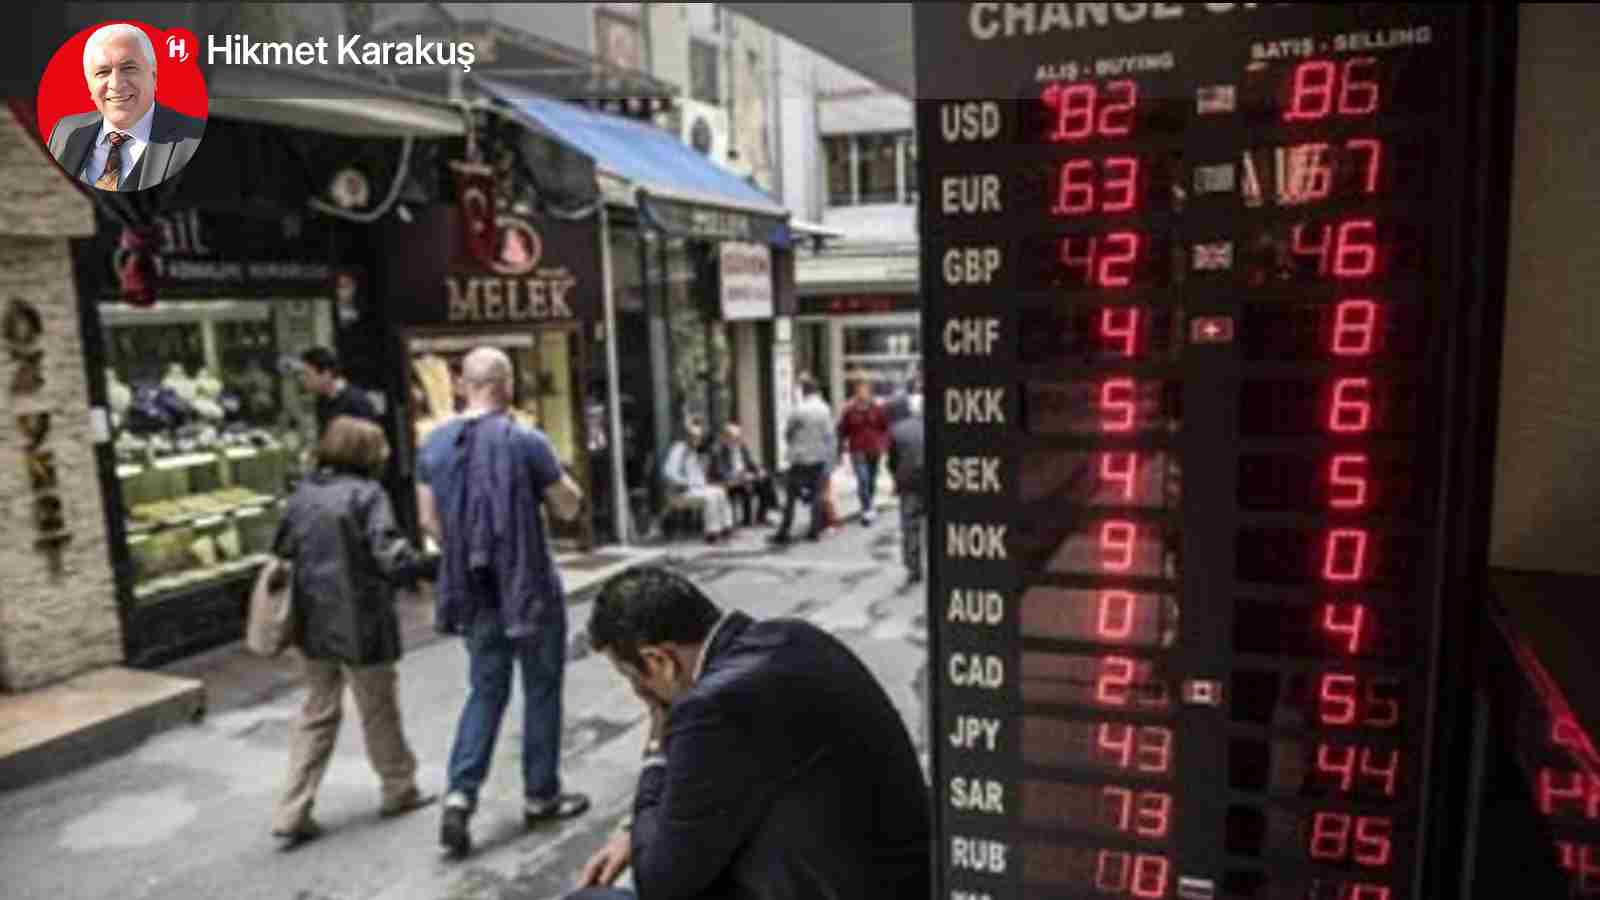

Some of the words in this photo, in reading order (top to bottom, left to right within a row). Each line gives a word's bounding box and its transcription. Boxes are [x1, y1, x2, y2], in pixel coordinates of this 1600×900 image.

[1096, 52, 1174, 76] BUYING
[942, 101, 1001, 141] USD
[942, 174, 1002, 214] EUR
[943, 248, 1000, 285] GBP
[445, 277, 577, 320] MELEK
[943, 318, 1000, 356] CHF
[1101, 306, 1138, 356] 4
[1331, 300, 1376, 356] 8
[946, 387, 1005, 424] DKK
[1100, 378, 1136, 432] 5
[1329, 378, 1371, 433] 6
[946, 456, 1001, 493] SEK
[1100, 451, 1137, 501] 4
[1329, 455, 1368, 508] 5
[947, 522, 1007, 559] NOK
[1100, 520, 1136, 572] 9
[1322, 529, 1367, 582] 0
[947, 588, 1004, 624] AUD
[1098, 589, 1136, 639] 0
[1323, 603, 1364, 653] 4
[950, 652, 1004, 689] CAD
[949, 716, 1001, 750] JPY
[1098, 721, 1172, 773] 43
[1317, 744, 1398, 795] 44
[950, 777, 1003, 813] SAR
[1103, 784, 1172, 836] 73
[1310, 812, 1391, 866] 85
[951, 836, 1007, 873] RUB
